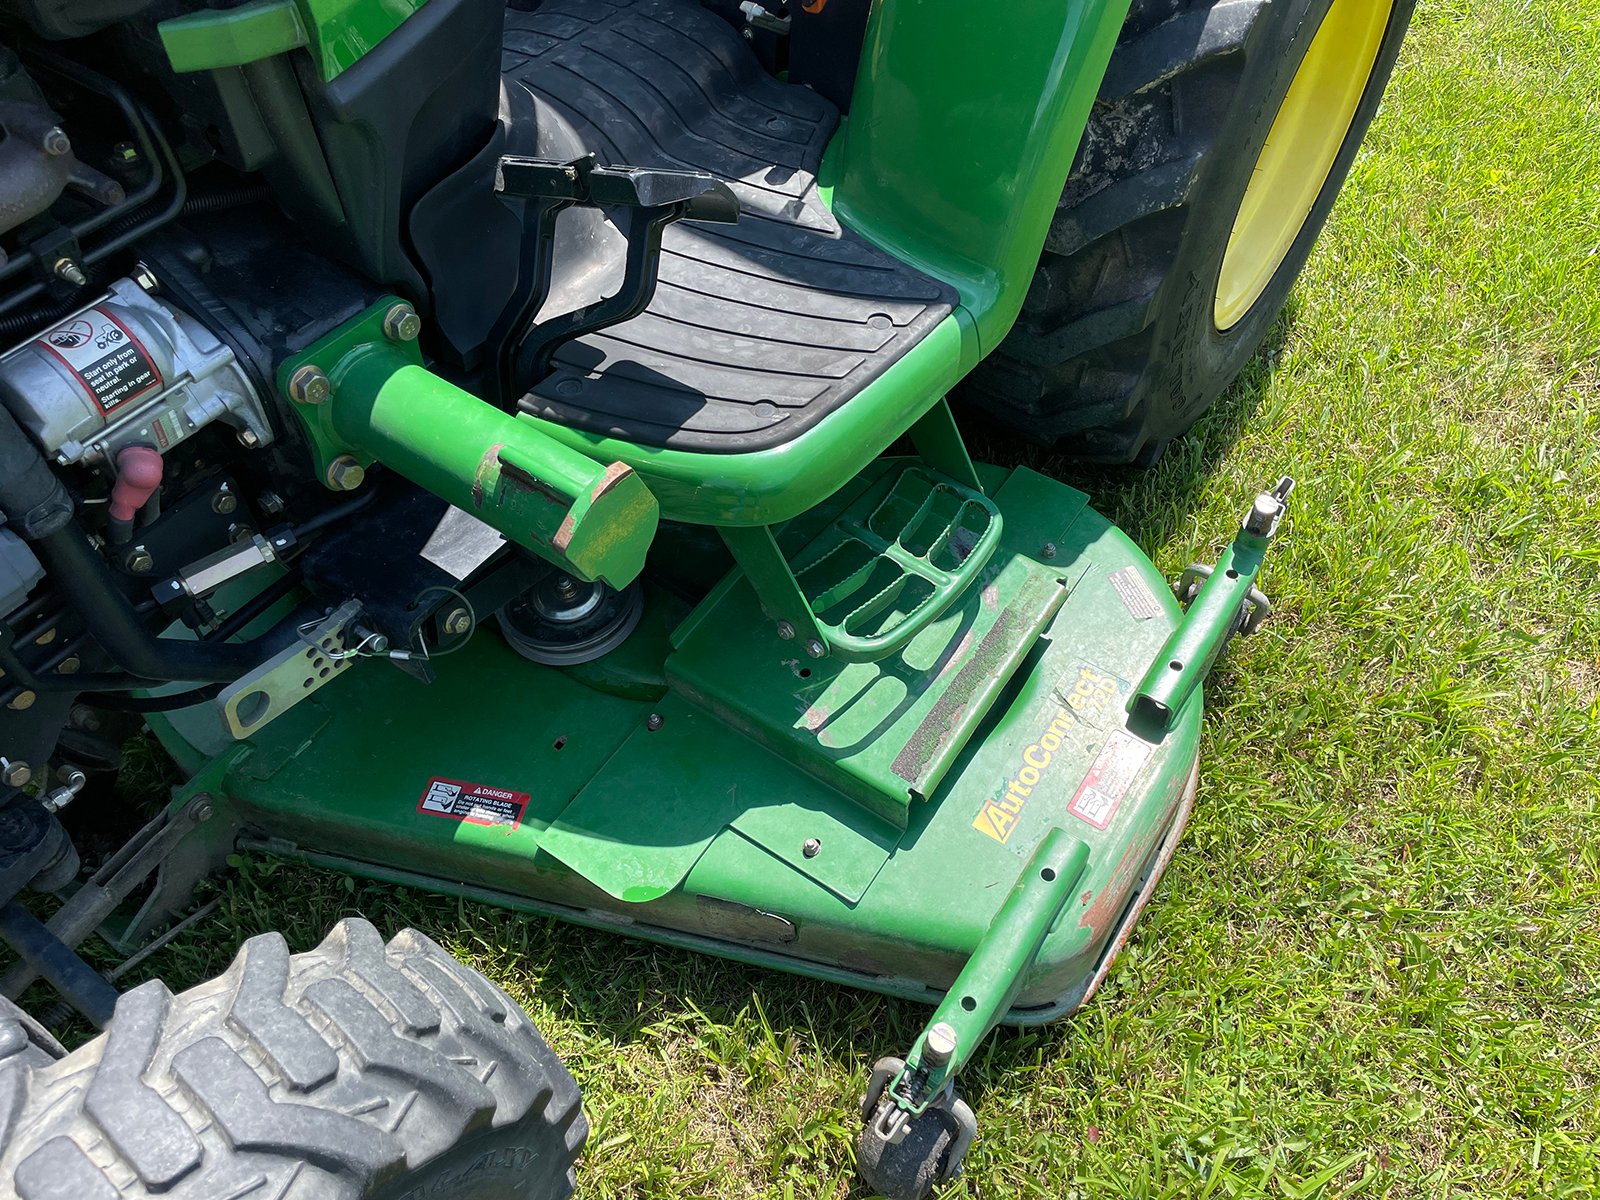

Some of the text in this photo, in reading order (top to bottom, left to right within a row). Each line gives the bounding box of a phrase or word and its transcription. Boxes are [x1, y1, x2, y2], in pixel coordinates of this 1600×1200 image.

[1169, 270, 1200, 412] GALAXY
[84, 348, 135, 380] Start only from
[90, 356, 138, 387] seat in park or
[95, 376, 122, 394] neutral.
[101, 384, 129, 403] Starting
[135, 371, 151, 384] gear
[104, 398, 121, 409] kills.
[464, 795, 513, 809] ROTATING BLADE
[482, 788, 513, 800] DANGER
